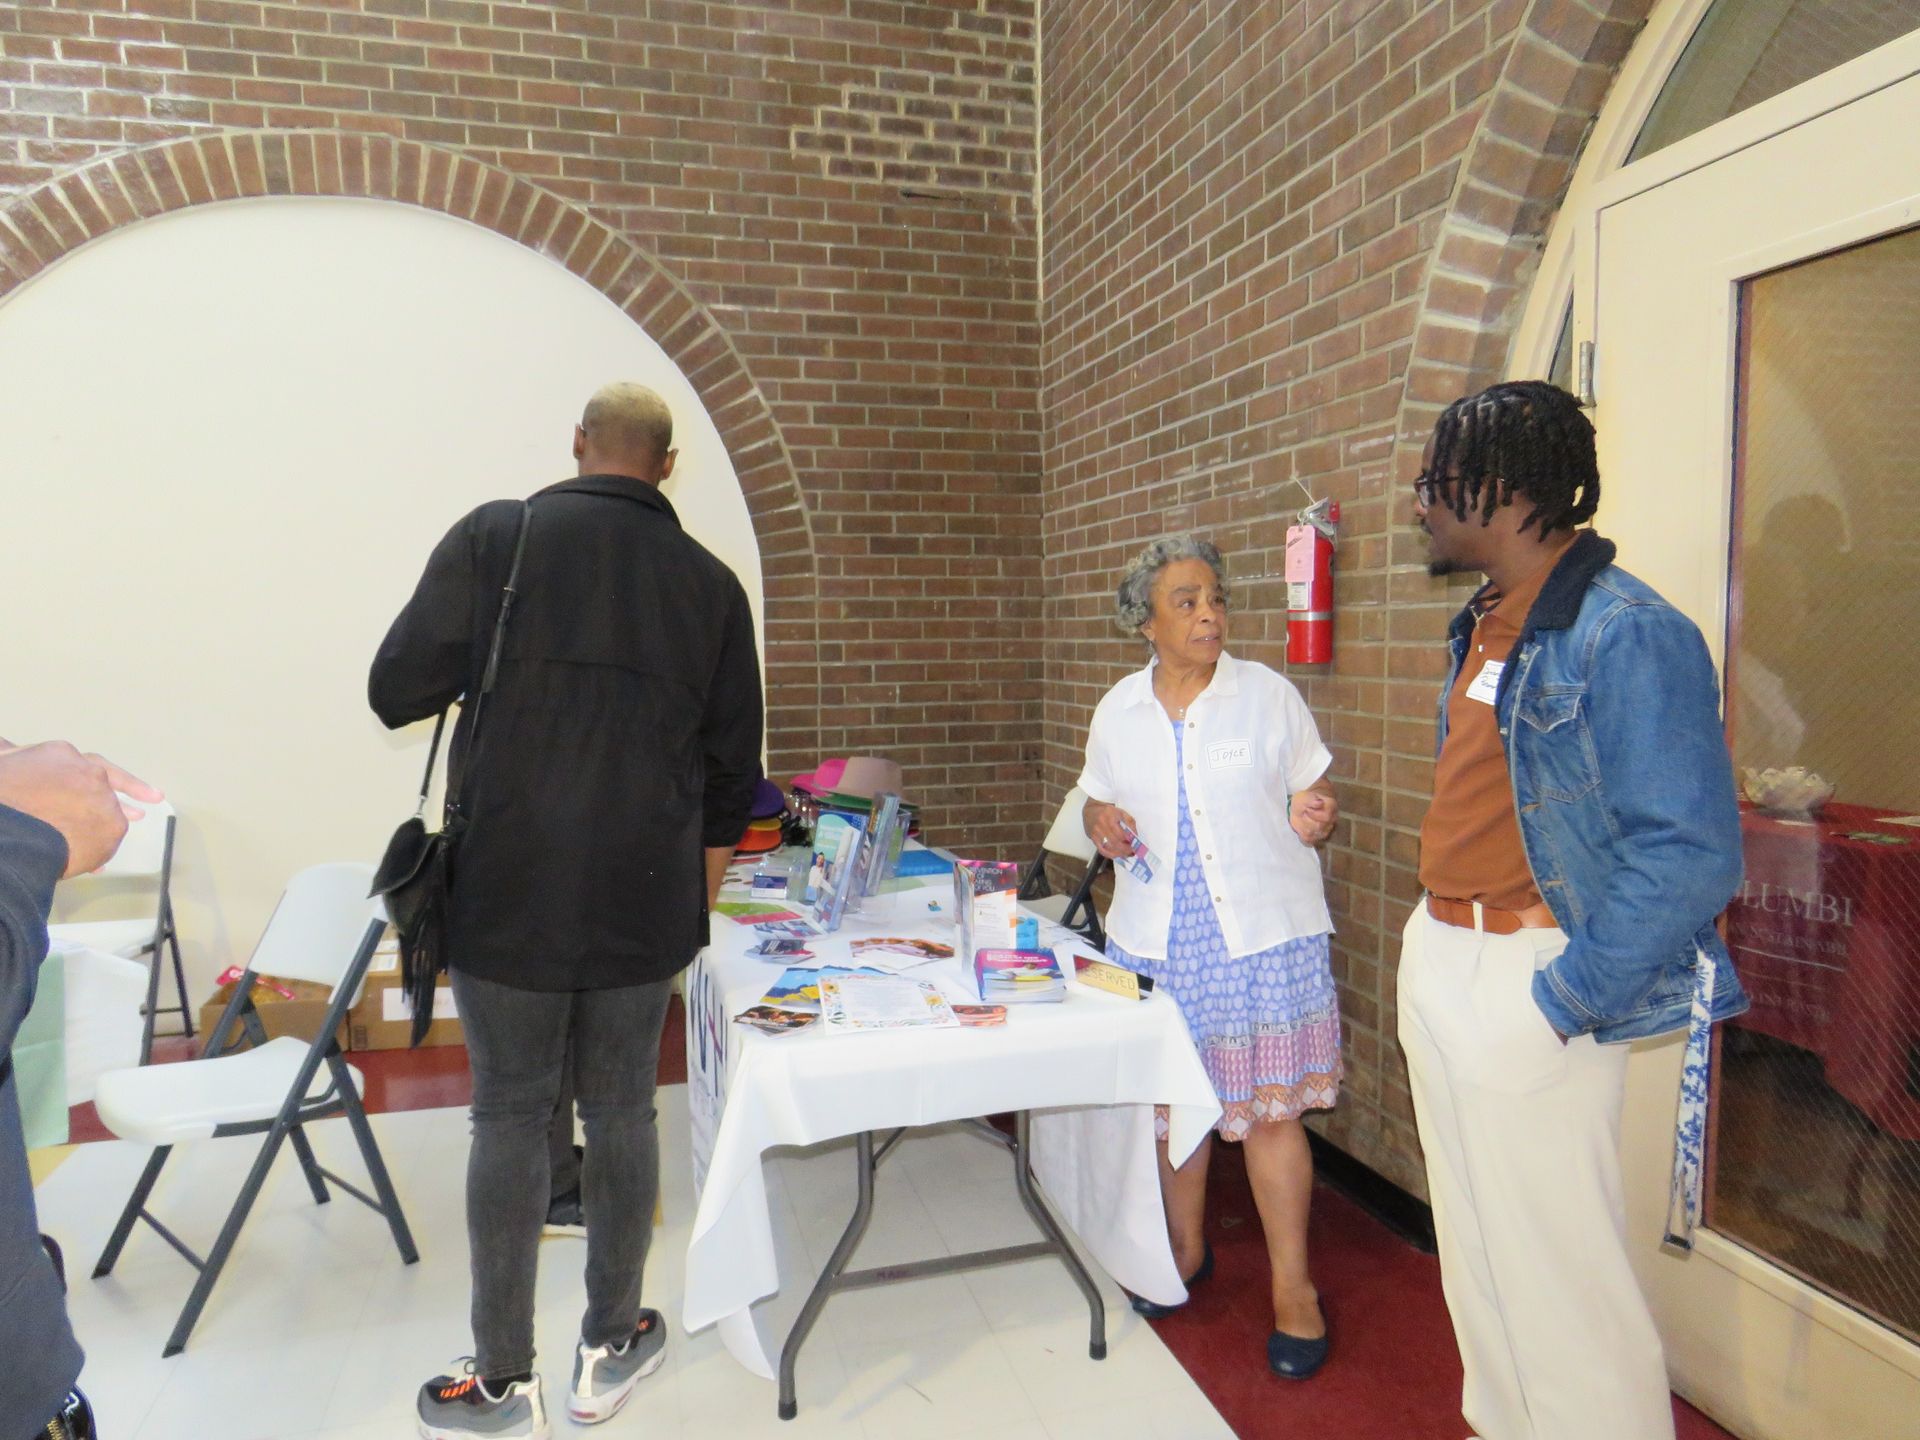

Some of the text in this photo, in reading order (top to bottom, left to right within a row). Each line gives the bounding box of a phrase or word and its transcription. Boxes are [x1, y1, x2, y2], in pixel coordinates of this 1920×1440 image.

[1210, 747, 1247, 761] JOYCE
[1741, 880, 1854, 927] LUMBI
[1083, 965, 1136, 991] ESERVED
